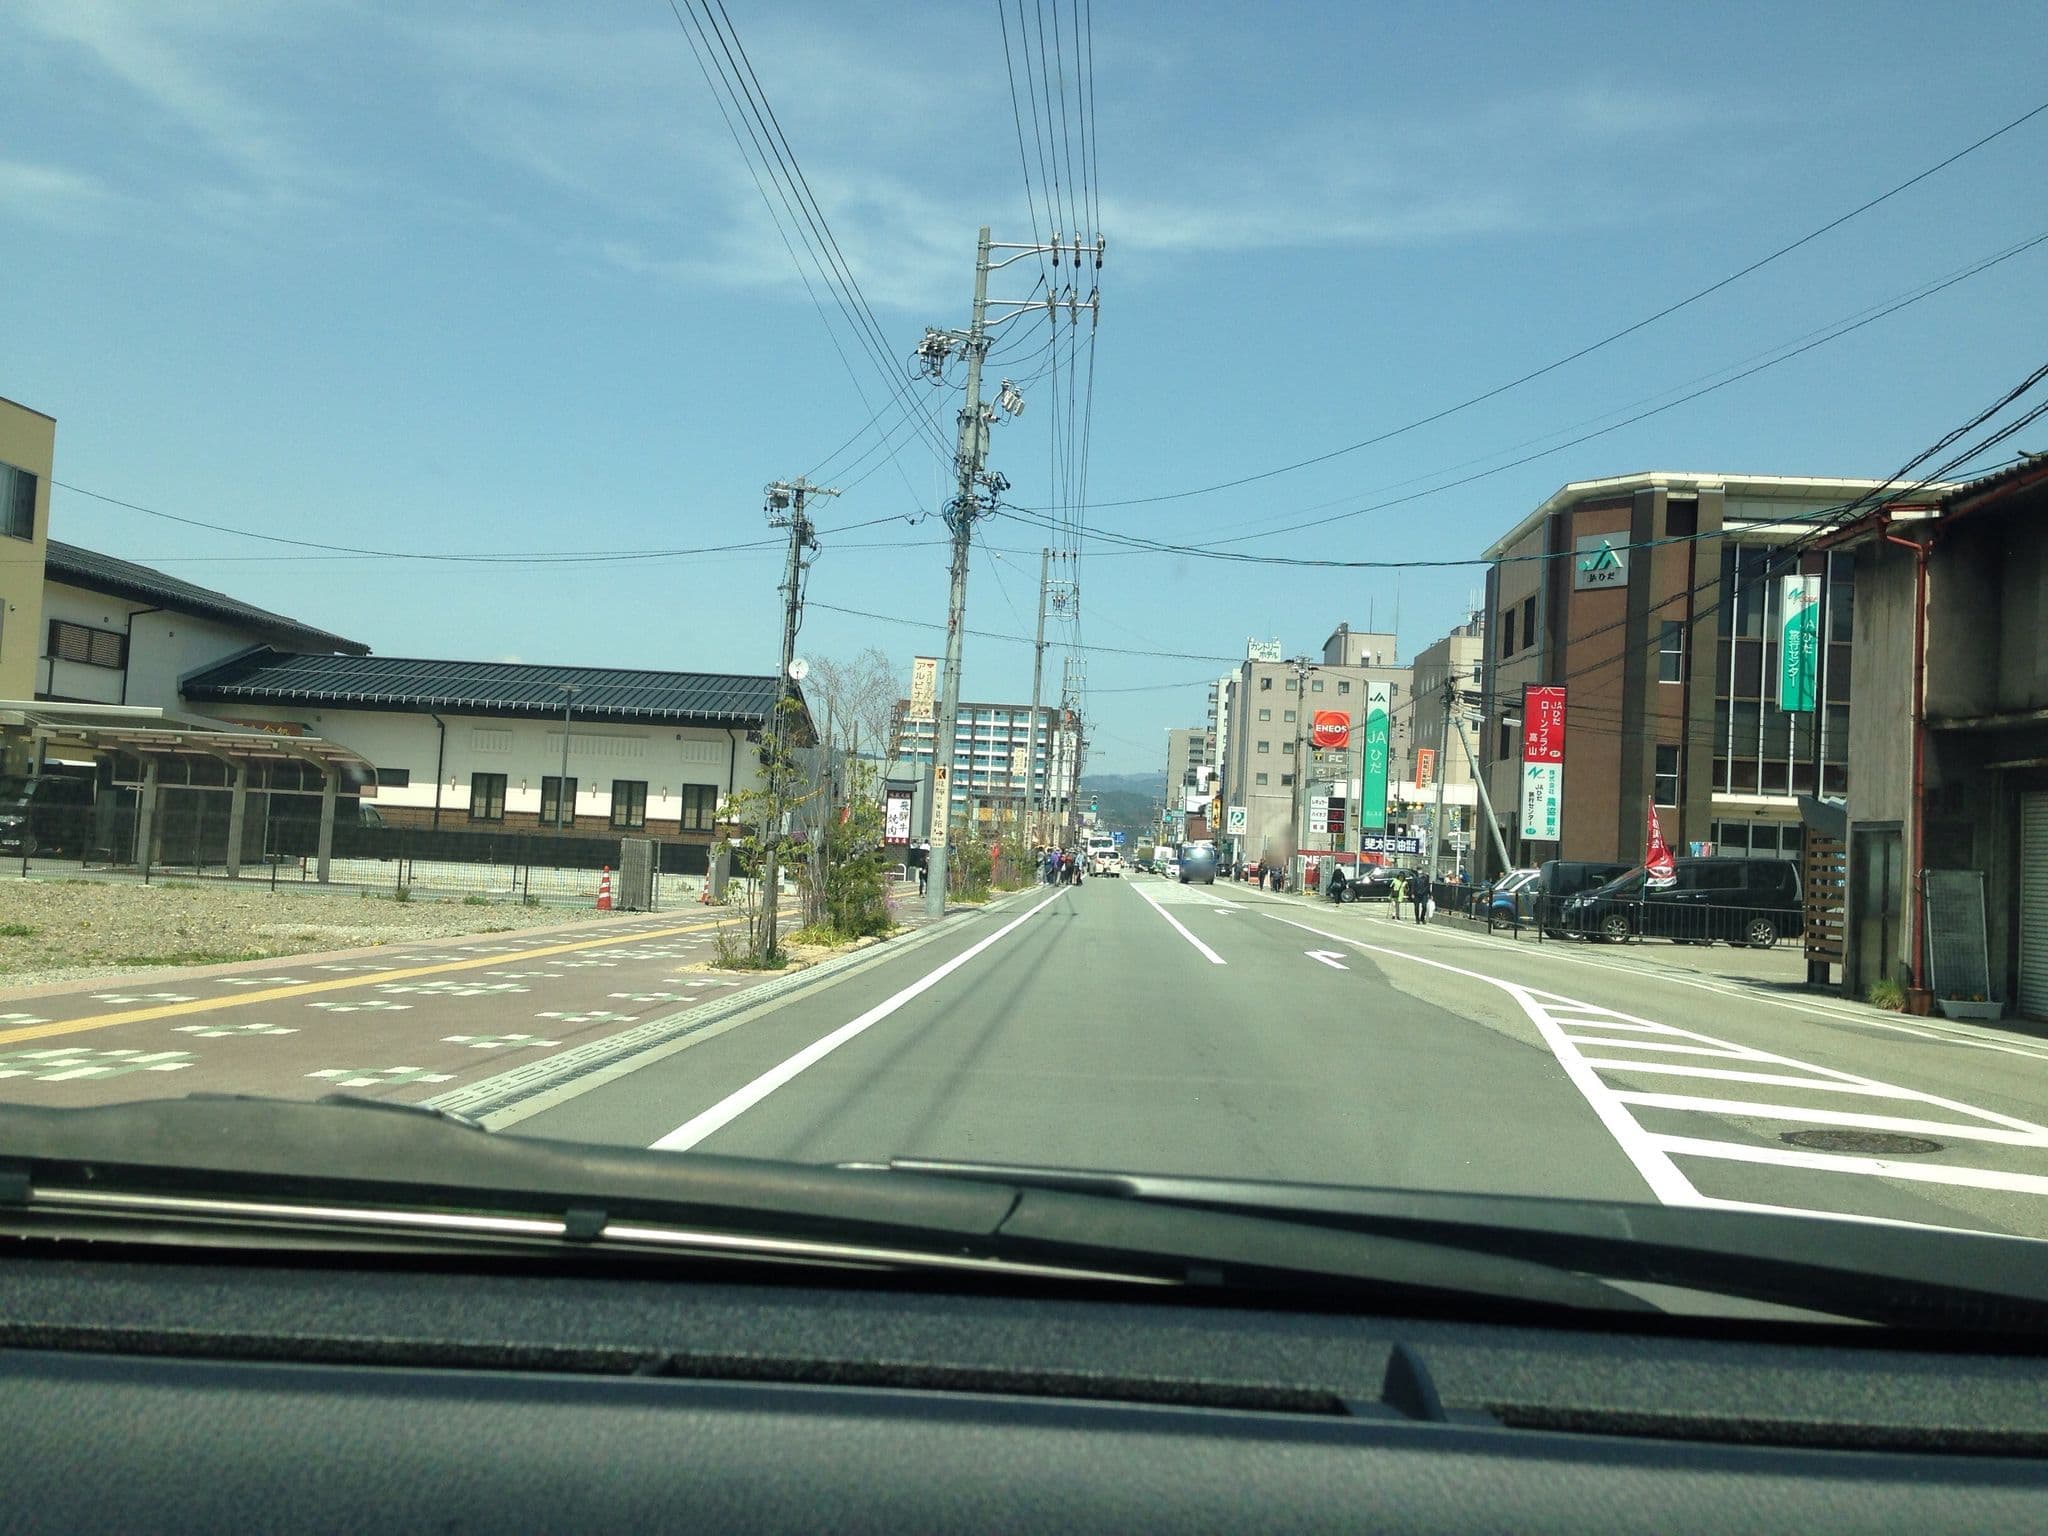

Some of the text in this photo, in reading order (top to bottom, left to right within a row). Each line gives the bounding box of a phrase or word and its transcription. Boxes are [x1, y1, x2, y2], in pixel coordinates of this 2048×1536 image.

[1550, 701, 1563, 726] JAひだ
[1315, 724, 1348, 733] ENEOS
[1367, 731, 1387, 774] JAひだ
[1528, 732, 1538, 756] 高山
